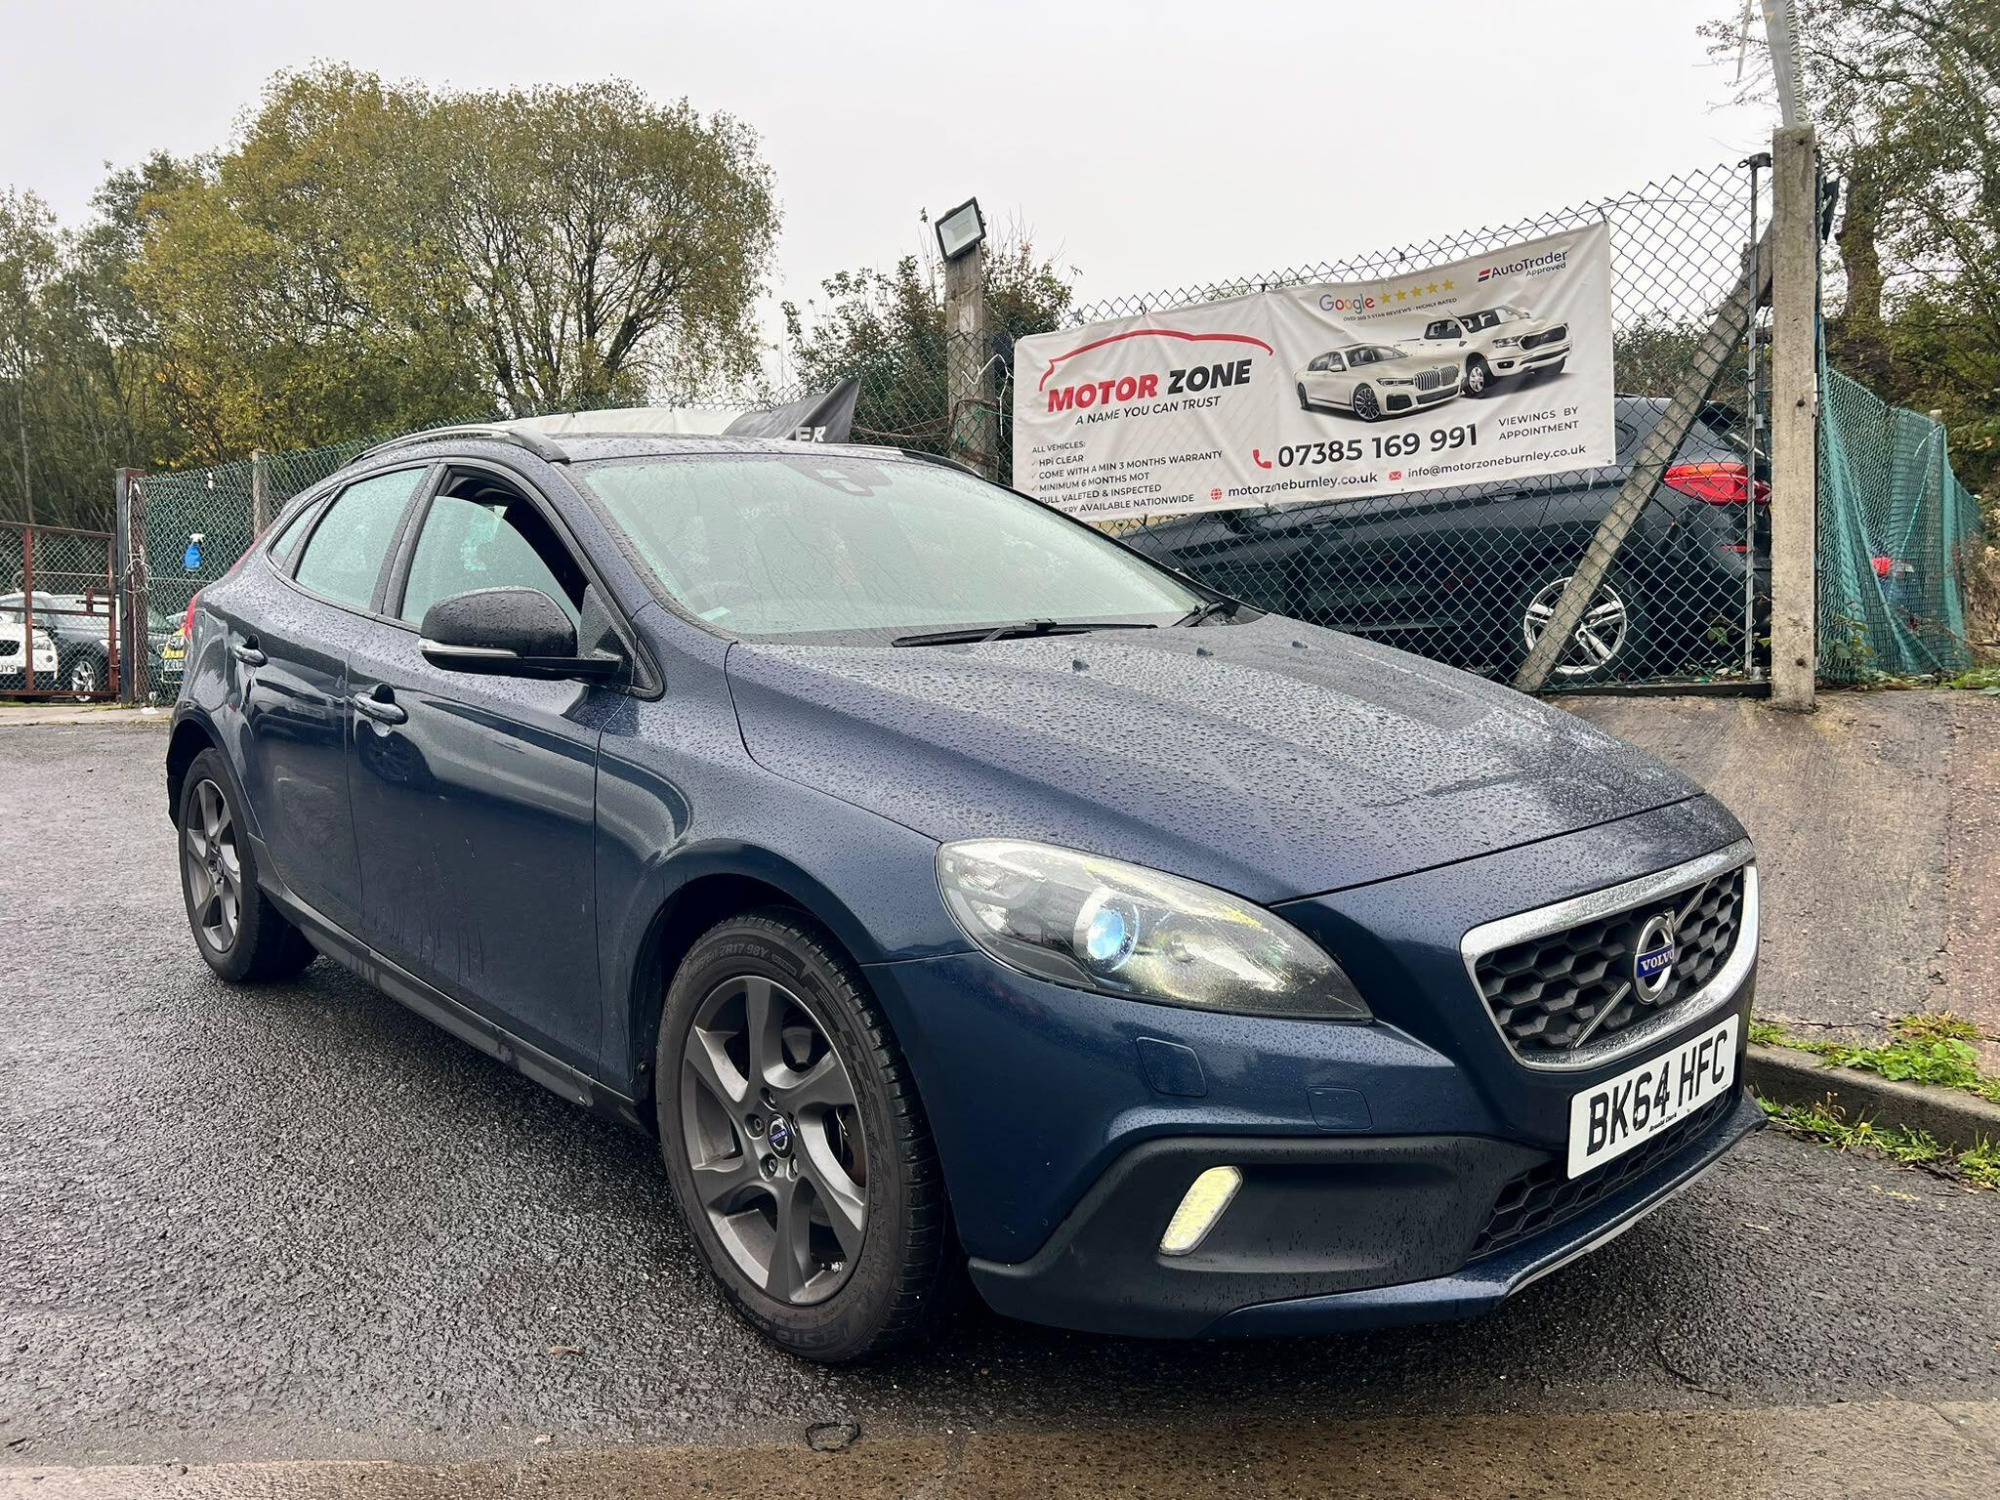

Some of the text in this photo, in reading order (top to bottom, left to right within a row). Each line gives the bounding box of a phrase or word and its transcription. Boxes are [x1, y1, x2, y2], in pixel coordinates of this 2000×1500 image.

[1491, 251, 1568, 279] AutoTrader
[1525, 262, 1567, 278] Approved
[1319, 293, 1375, 314] Google
[1386, 307, 1412, 316] REVIEWS
[1415, 302, 1437, 311] HIGHLY
[1438, 297, 1457, 306] RATED
[1047, 359, 1253, 413] MOTOR ZONE
[1075, 395, 1221, 426] A NAME YOU CAN TRUST
[1498, 406, 1579, 427] VIEWINGS BY
[1498, 420, 1580, 441] APPOINTMENT
[1031, 440, 1086, 454] ALL VEHICLES:
[1278, 423, 1478, 469] 07385 169 991
[1039, 450, 1223, 480] COME WITH A MIN 3 MONTHS WARRANTY
[1055, 454, 1084, 465] CLEAR
[1407, 444, 1586, 479] info@motorzoneburnley.co.uk
[1039, 472, 1150, 492] MINIMUM 6 MONTHS MOT
[1061, 490, 1100, 502] VALETED
[1102, 489, 1109, 497] &
[1110, 484, 1162, 497] INSPECTED
[1079, 501, 1131, 512] AVAILABLE
[1133, 494, 1195, 507] NATIONWIDE
[1640, 949, 1675, 971] VOLVO
[1586, 1029, 1728, 1157] BK64 HFC
